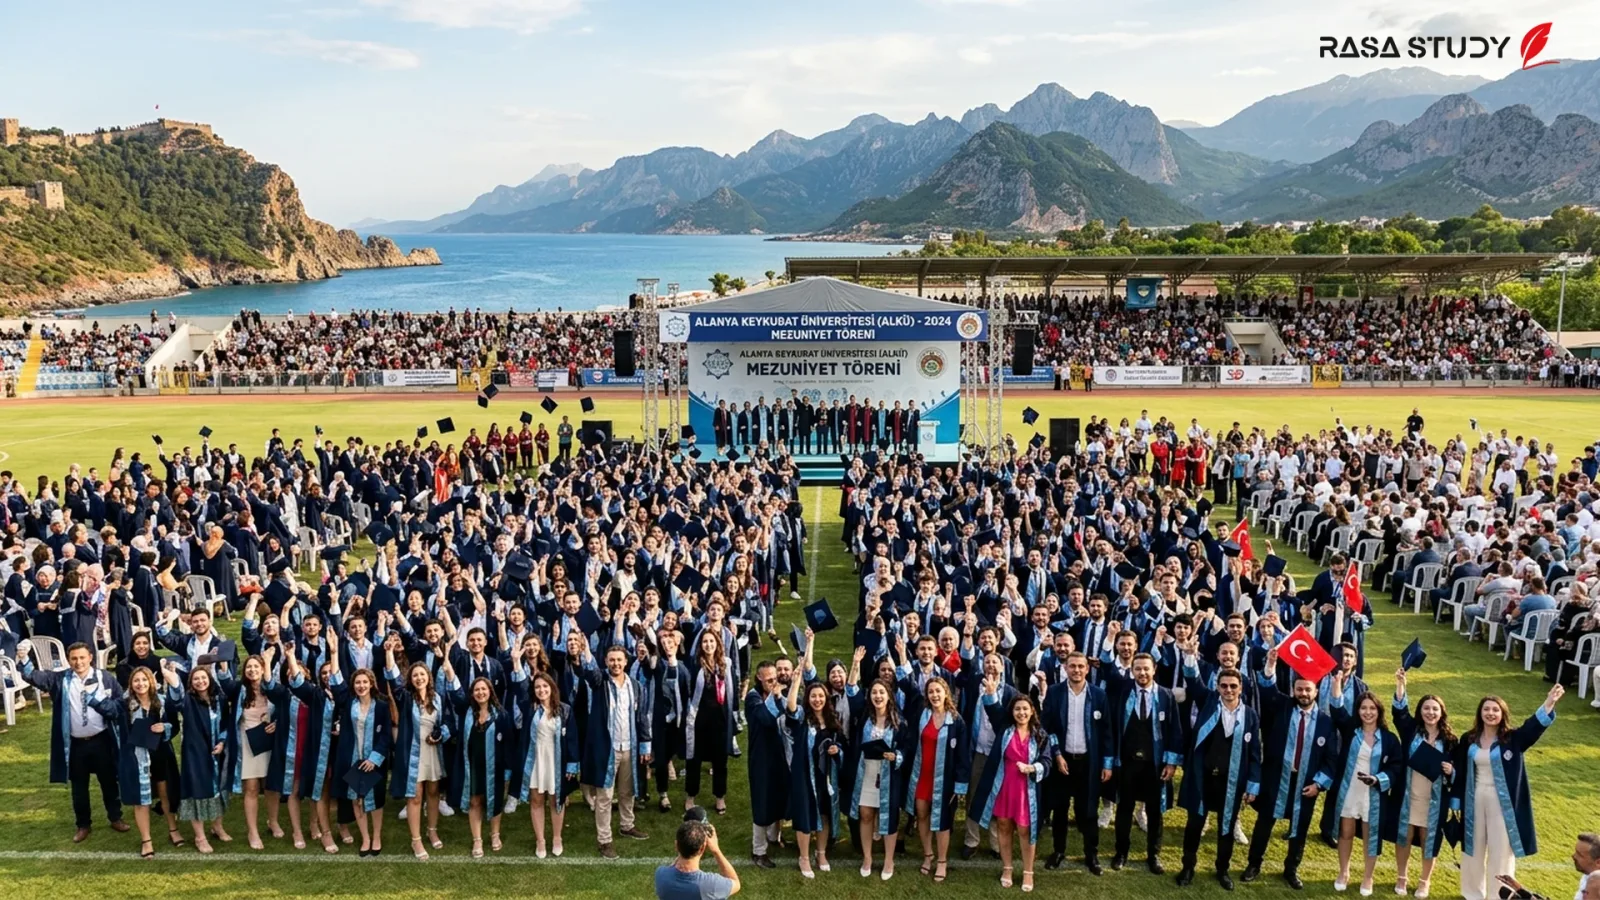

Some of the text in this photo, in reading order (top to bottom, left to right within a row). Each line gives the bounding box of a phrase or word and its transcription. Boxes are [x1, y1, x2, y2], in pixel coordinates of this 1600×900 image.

[695, 316, 739, 327] ALANYA
[877, 314, 915, 328] (ALKÜ)
[924, 316, 952, 327] 2024
[747, 360, 838, 376] MEZUNİYET
[843, 360, 901, 376] TÖRENİ
